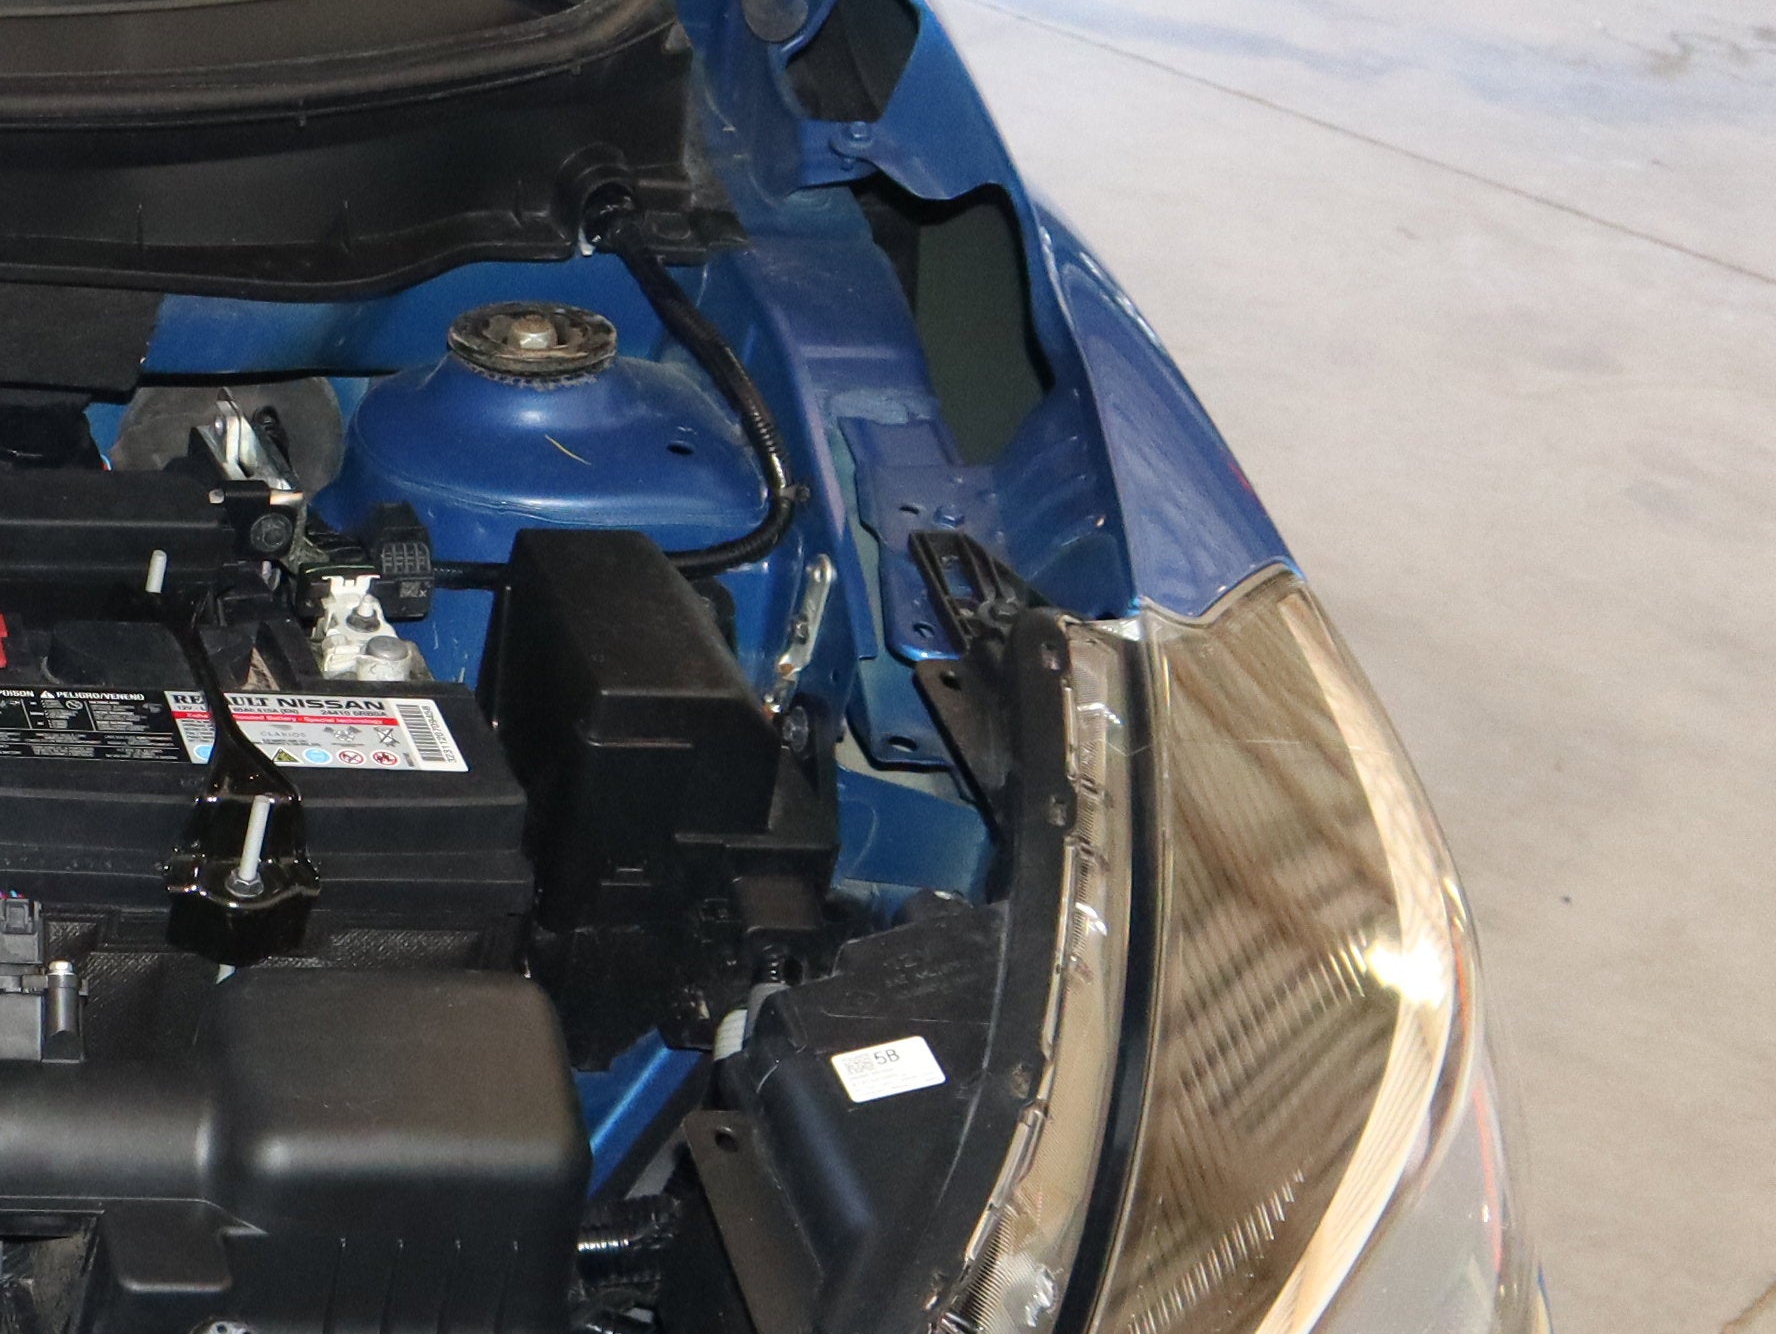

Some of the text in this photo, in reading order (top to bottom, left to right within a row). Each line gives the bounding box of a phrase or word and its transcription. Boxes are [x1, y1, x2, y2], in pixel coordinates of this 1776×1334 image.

[55, 690, 145, 701] PELIGRO/VENENO
[279, 698, 385, 711] NISSAN
[873, 1048, 901, 1066] 5B
